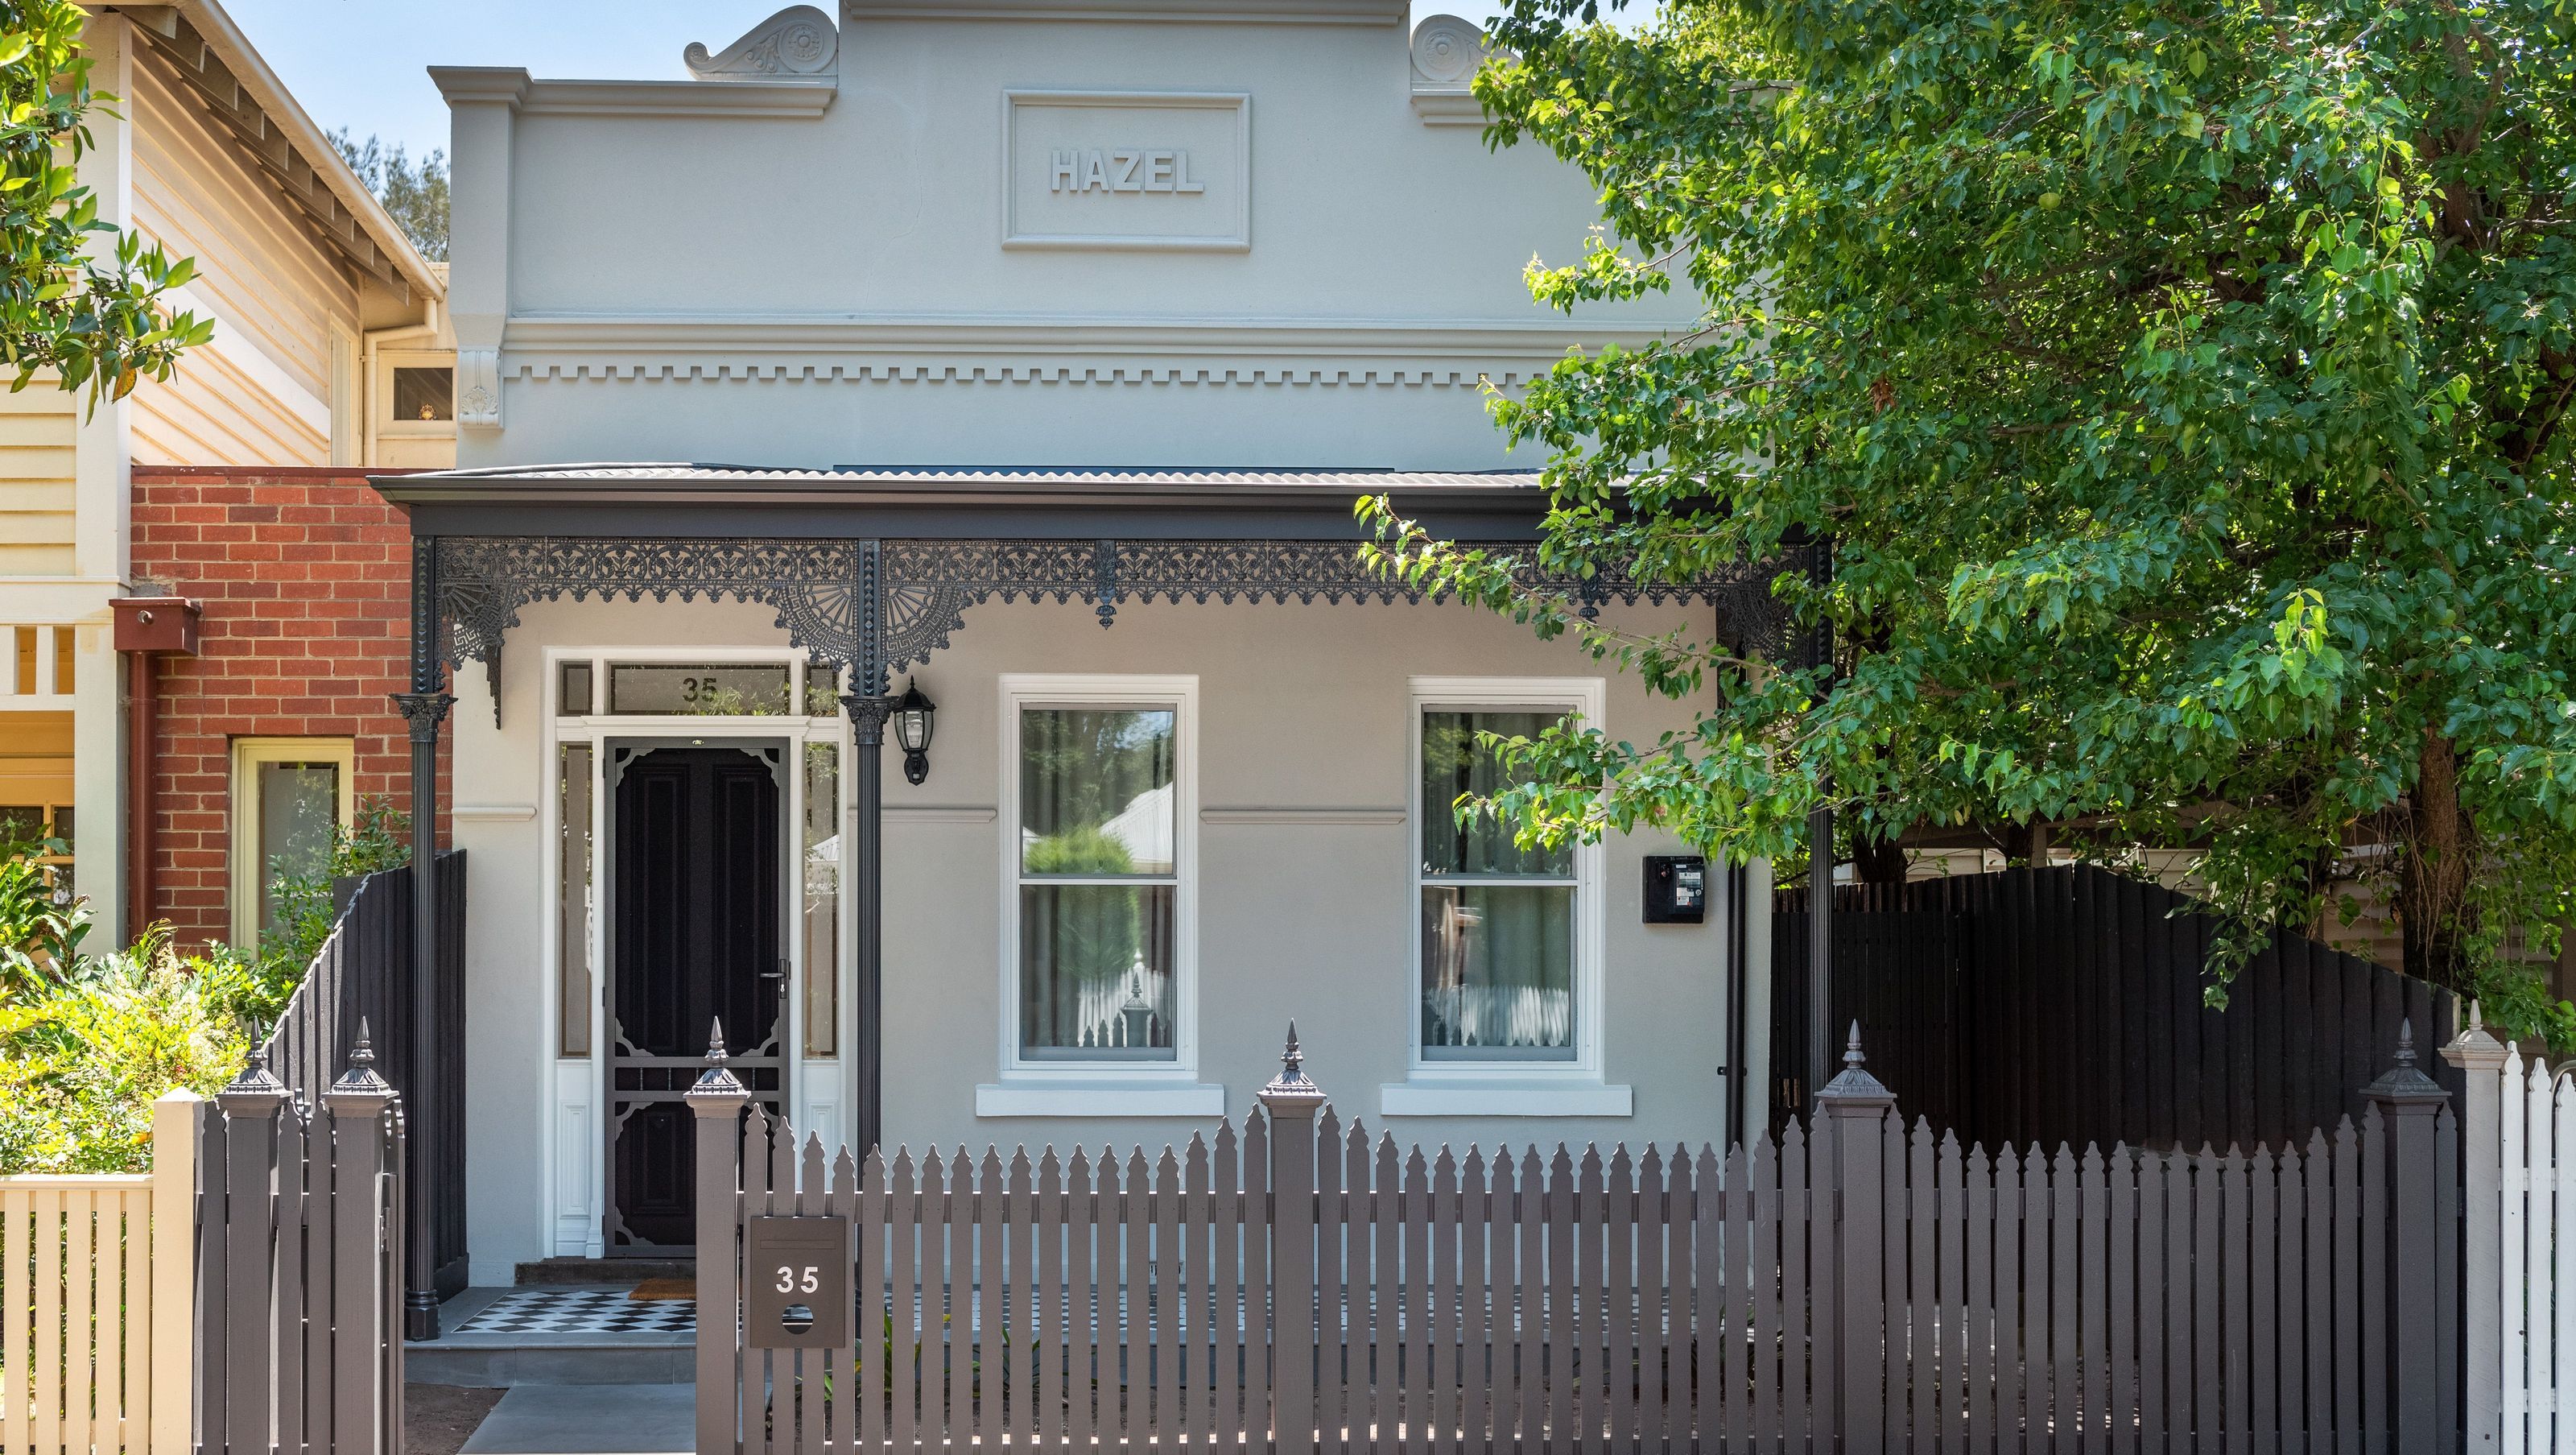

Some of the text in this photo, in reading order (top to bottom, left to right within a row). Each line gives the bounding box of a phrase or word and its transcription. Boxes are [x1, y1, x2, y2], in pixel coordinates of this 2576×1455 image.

[1051, 150, 1204, 193] HAZEL
[683, 677, 717, 702] 35
[776, 1266, 819, 1294] 35
